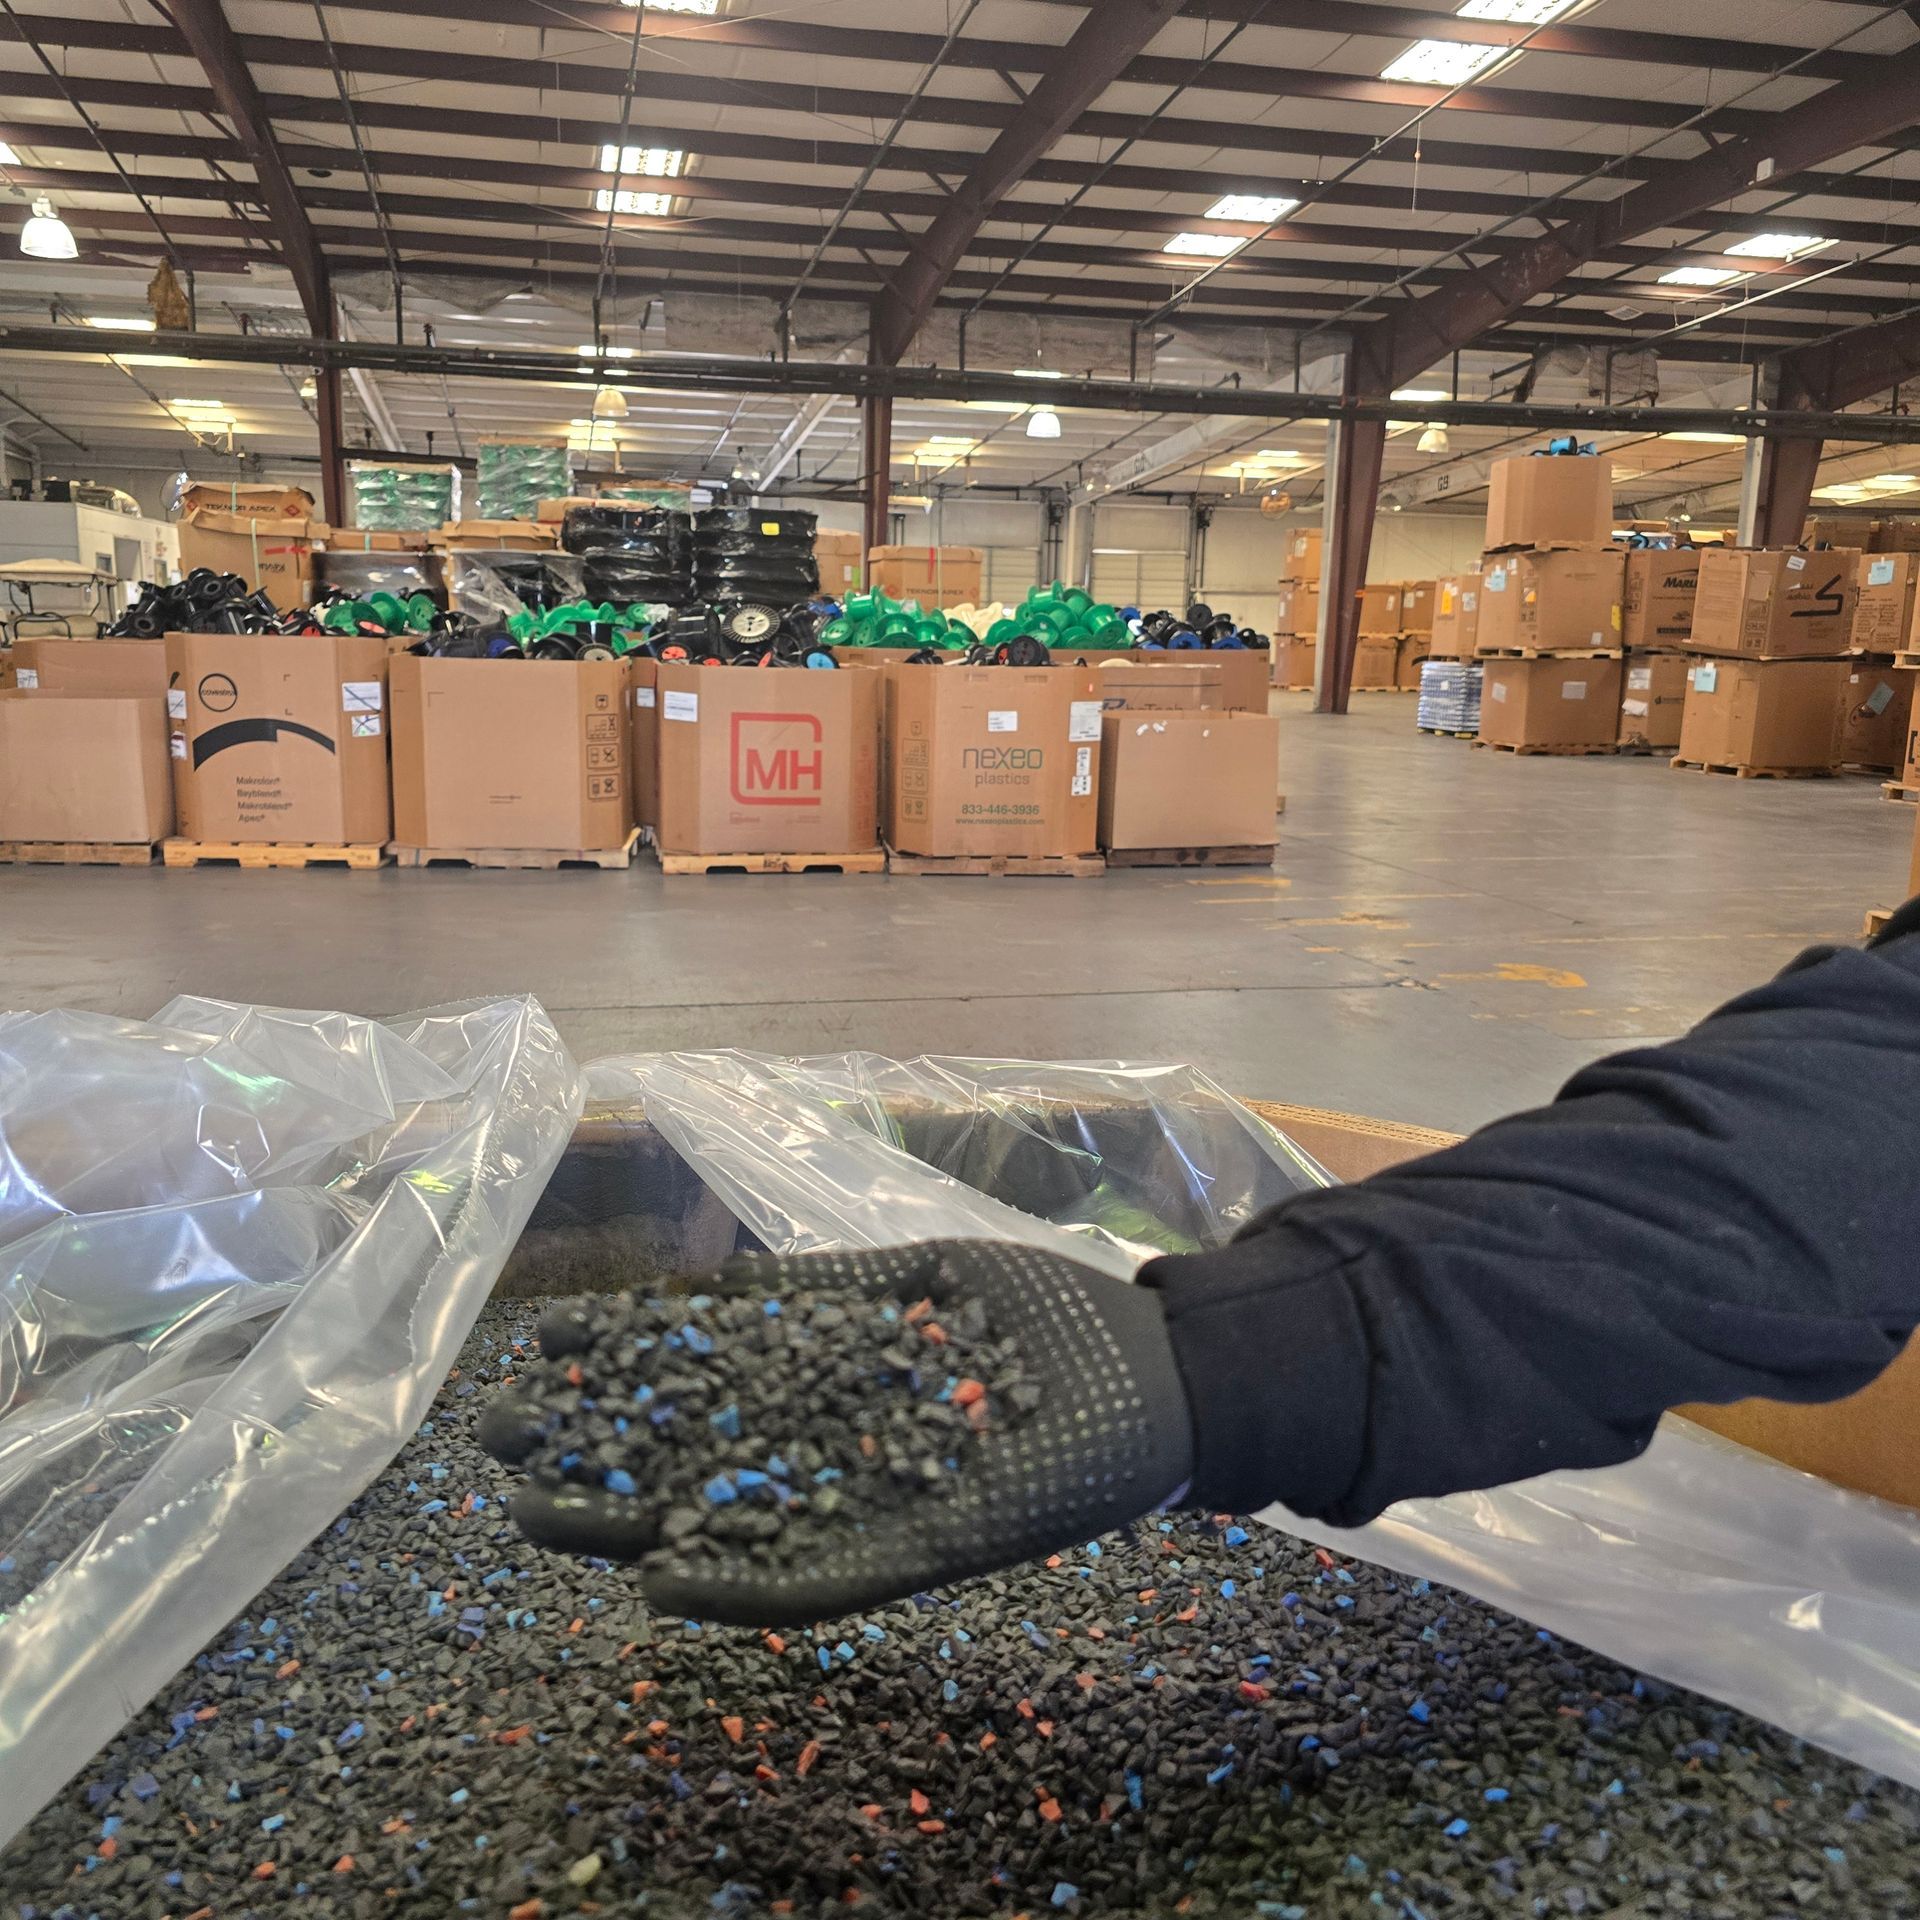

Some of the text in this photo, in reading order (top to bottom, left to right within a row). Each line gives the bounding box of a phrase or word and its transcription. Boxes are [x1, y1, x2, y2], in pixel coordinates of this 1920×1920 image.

[962, 747, 1043, 770] nexeo
[746, 748, 822, 790] MH
[975, 771, 1030, 788] plastics
[961, 804, 1040, 815] 833-446-3936
